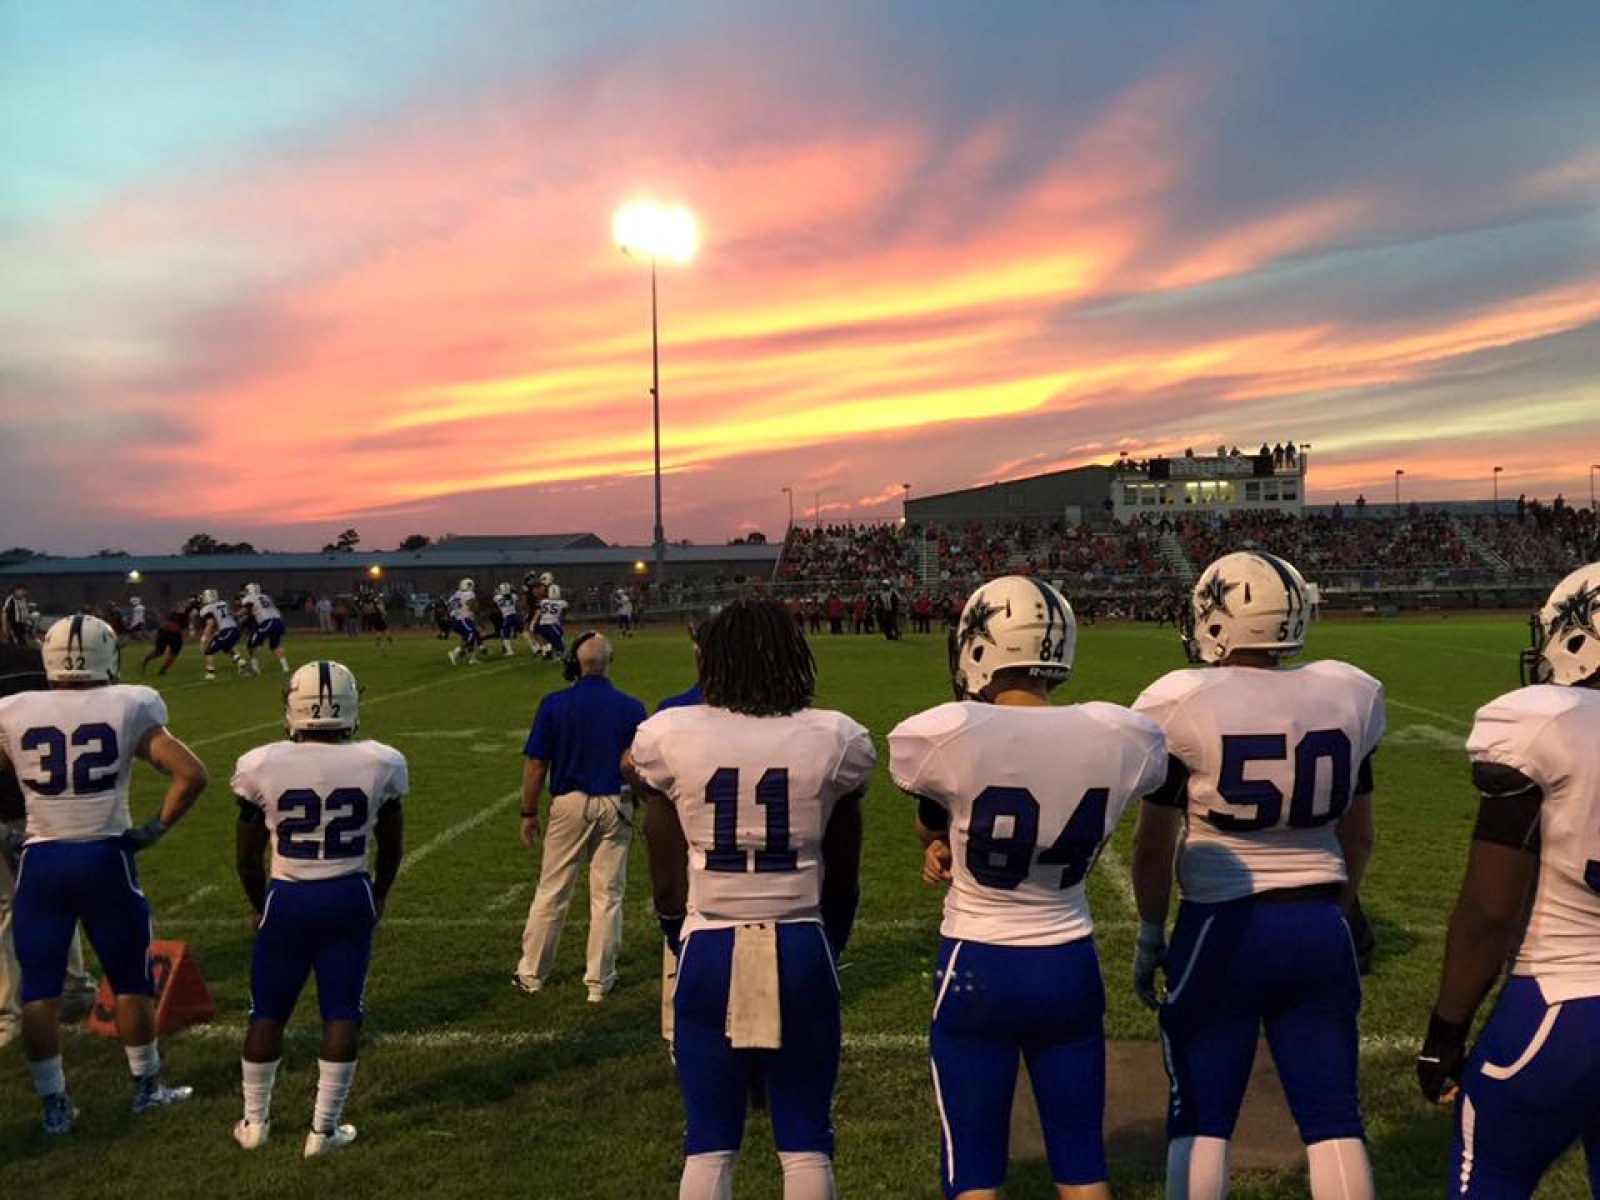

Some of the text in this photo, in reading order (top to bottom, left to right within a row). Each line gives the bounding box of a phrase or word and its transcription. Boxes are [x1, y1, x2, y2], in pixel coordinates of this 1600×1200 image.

[65, 657, 86, 671] 32
[1040, 639, 1066, 662] 84
[312, 705, 341, 719] 22
[20, 722, 119, 796] 32
[1206, 728, 1352, 832] 50
[276, 787, 369, 860] 22
[704, 767, 798, 873] 11
[965, 786, 1111, 890] 84
